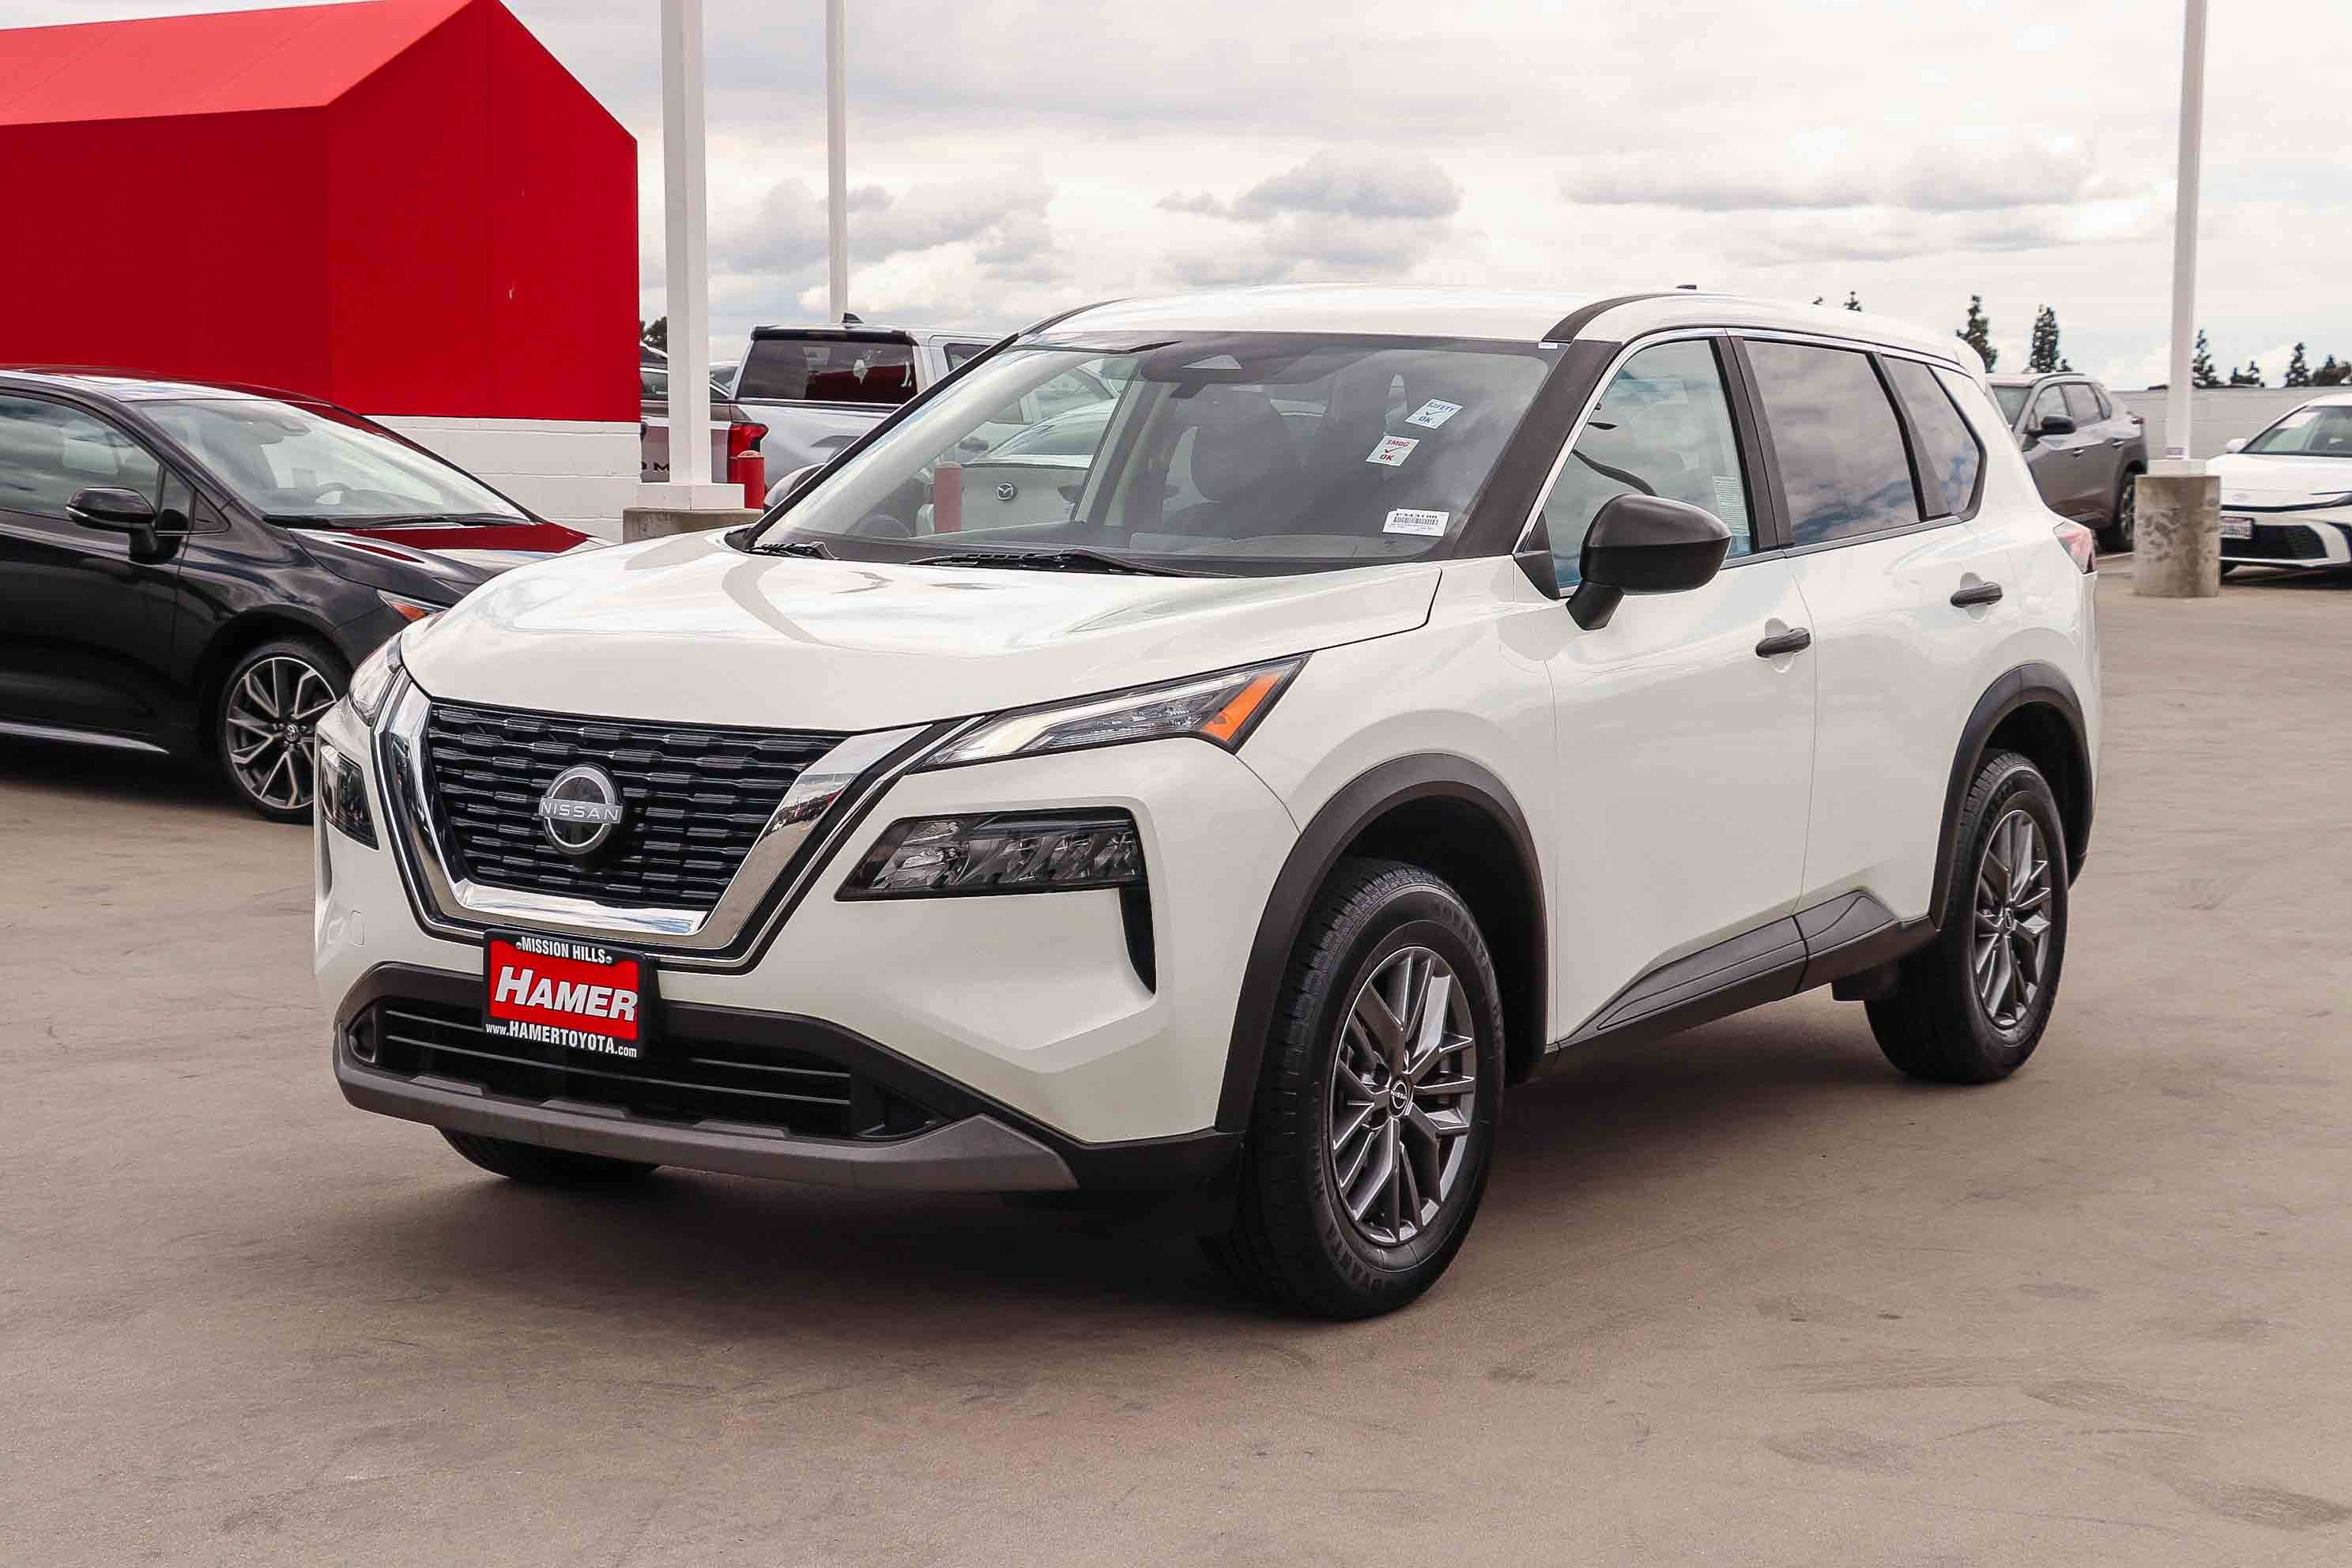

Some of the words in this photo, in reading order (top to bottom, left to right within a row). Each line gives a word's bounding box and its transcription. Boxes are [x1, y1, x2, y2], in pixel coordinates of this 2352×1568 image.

[1427, 401, 1456, 413] SAFETY
[540, 801, 620, 821] NISSAN
[522, 936, 569, 959] MISSION
[573, 944, 606, 964] HILLS
[494, 966, 639, 1022] HAMER
[485, 1020, 637, 1057] www.HAMERTOYOTA.com
